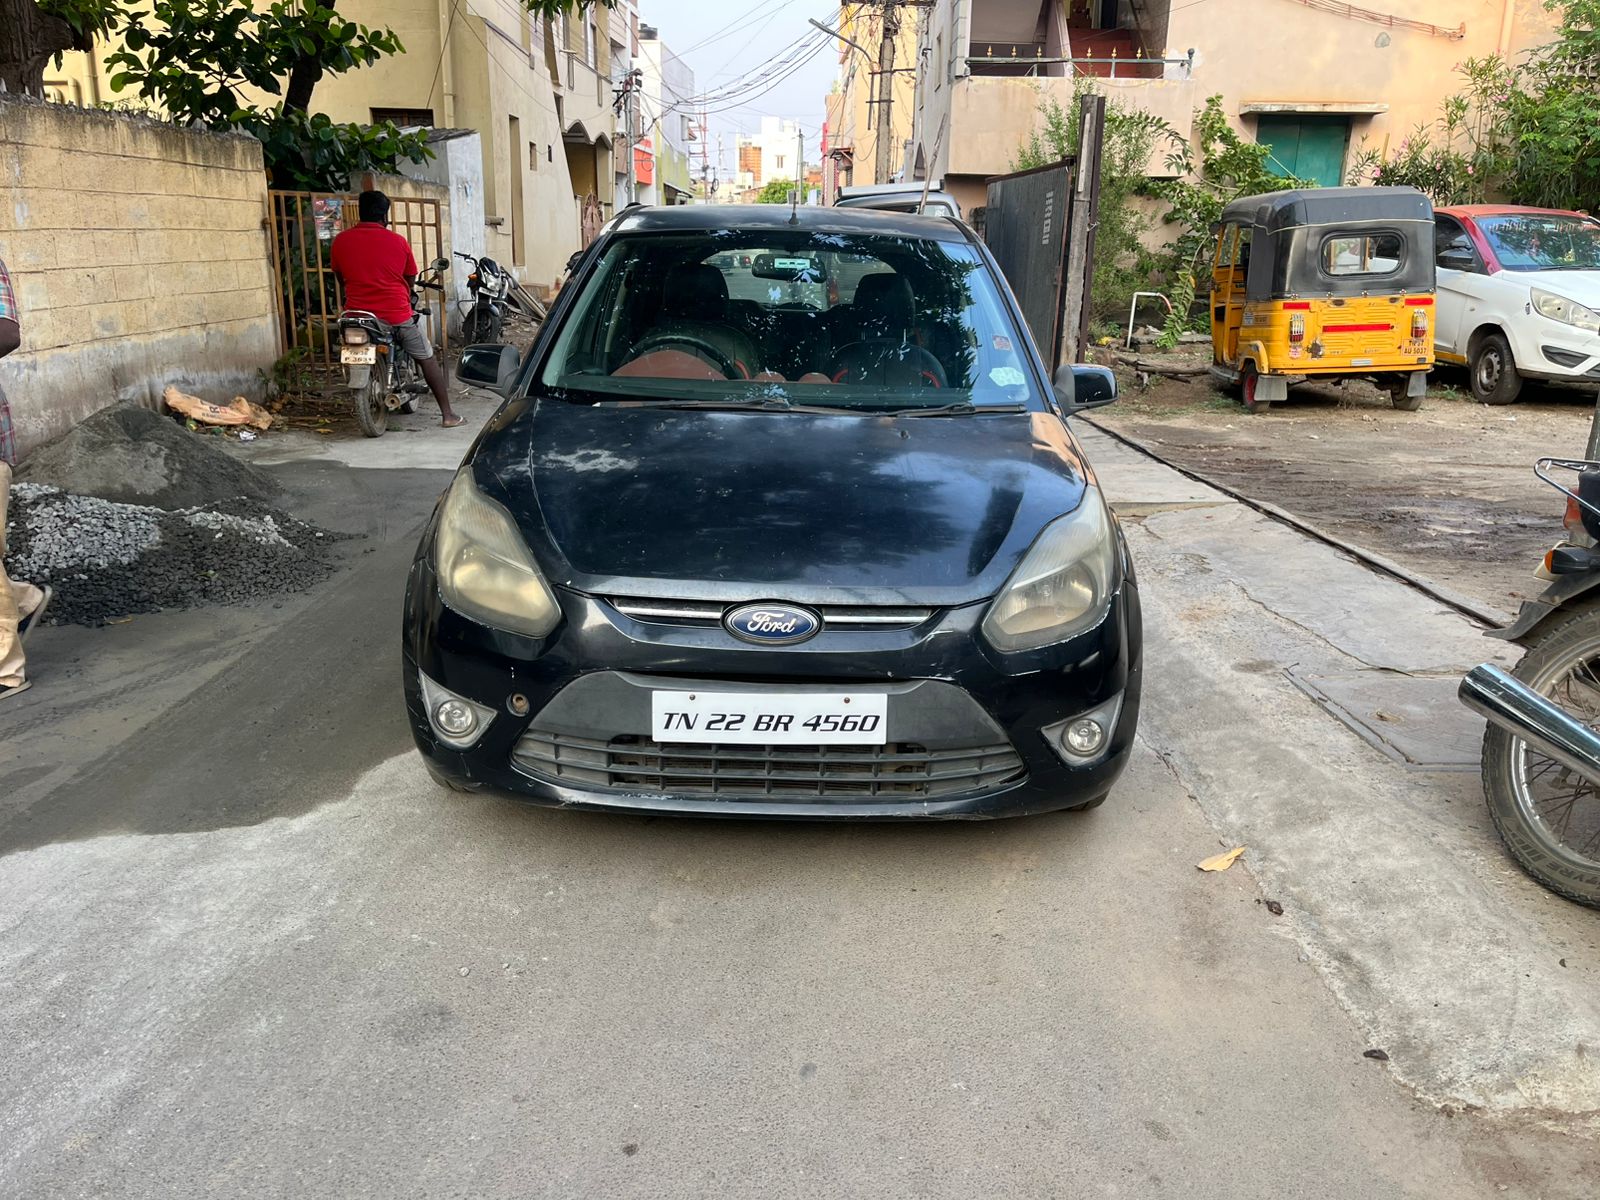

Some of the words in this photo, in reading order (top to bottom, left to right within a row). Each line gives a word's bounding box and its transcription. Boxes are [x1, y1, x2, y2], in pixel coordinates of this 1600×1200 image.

[747, 611, 797, 633] Ford
[663, 712, 699, 730] TN
[705, 713, 746, 731] 22
[752, 714, 795, 732] BR
[802, 714, 881, 732] 4560
